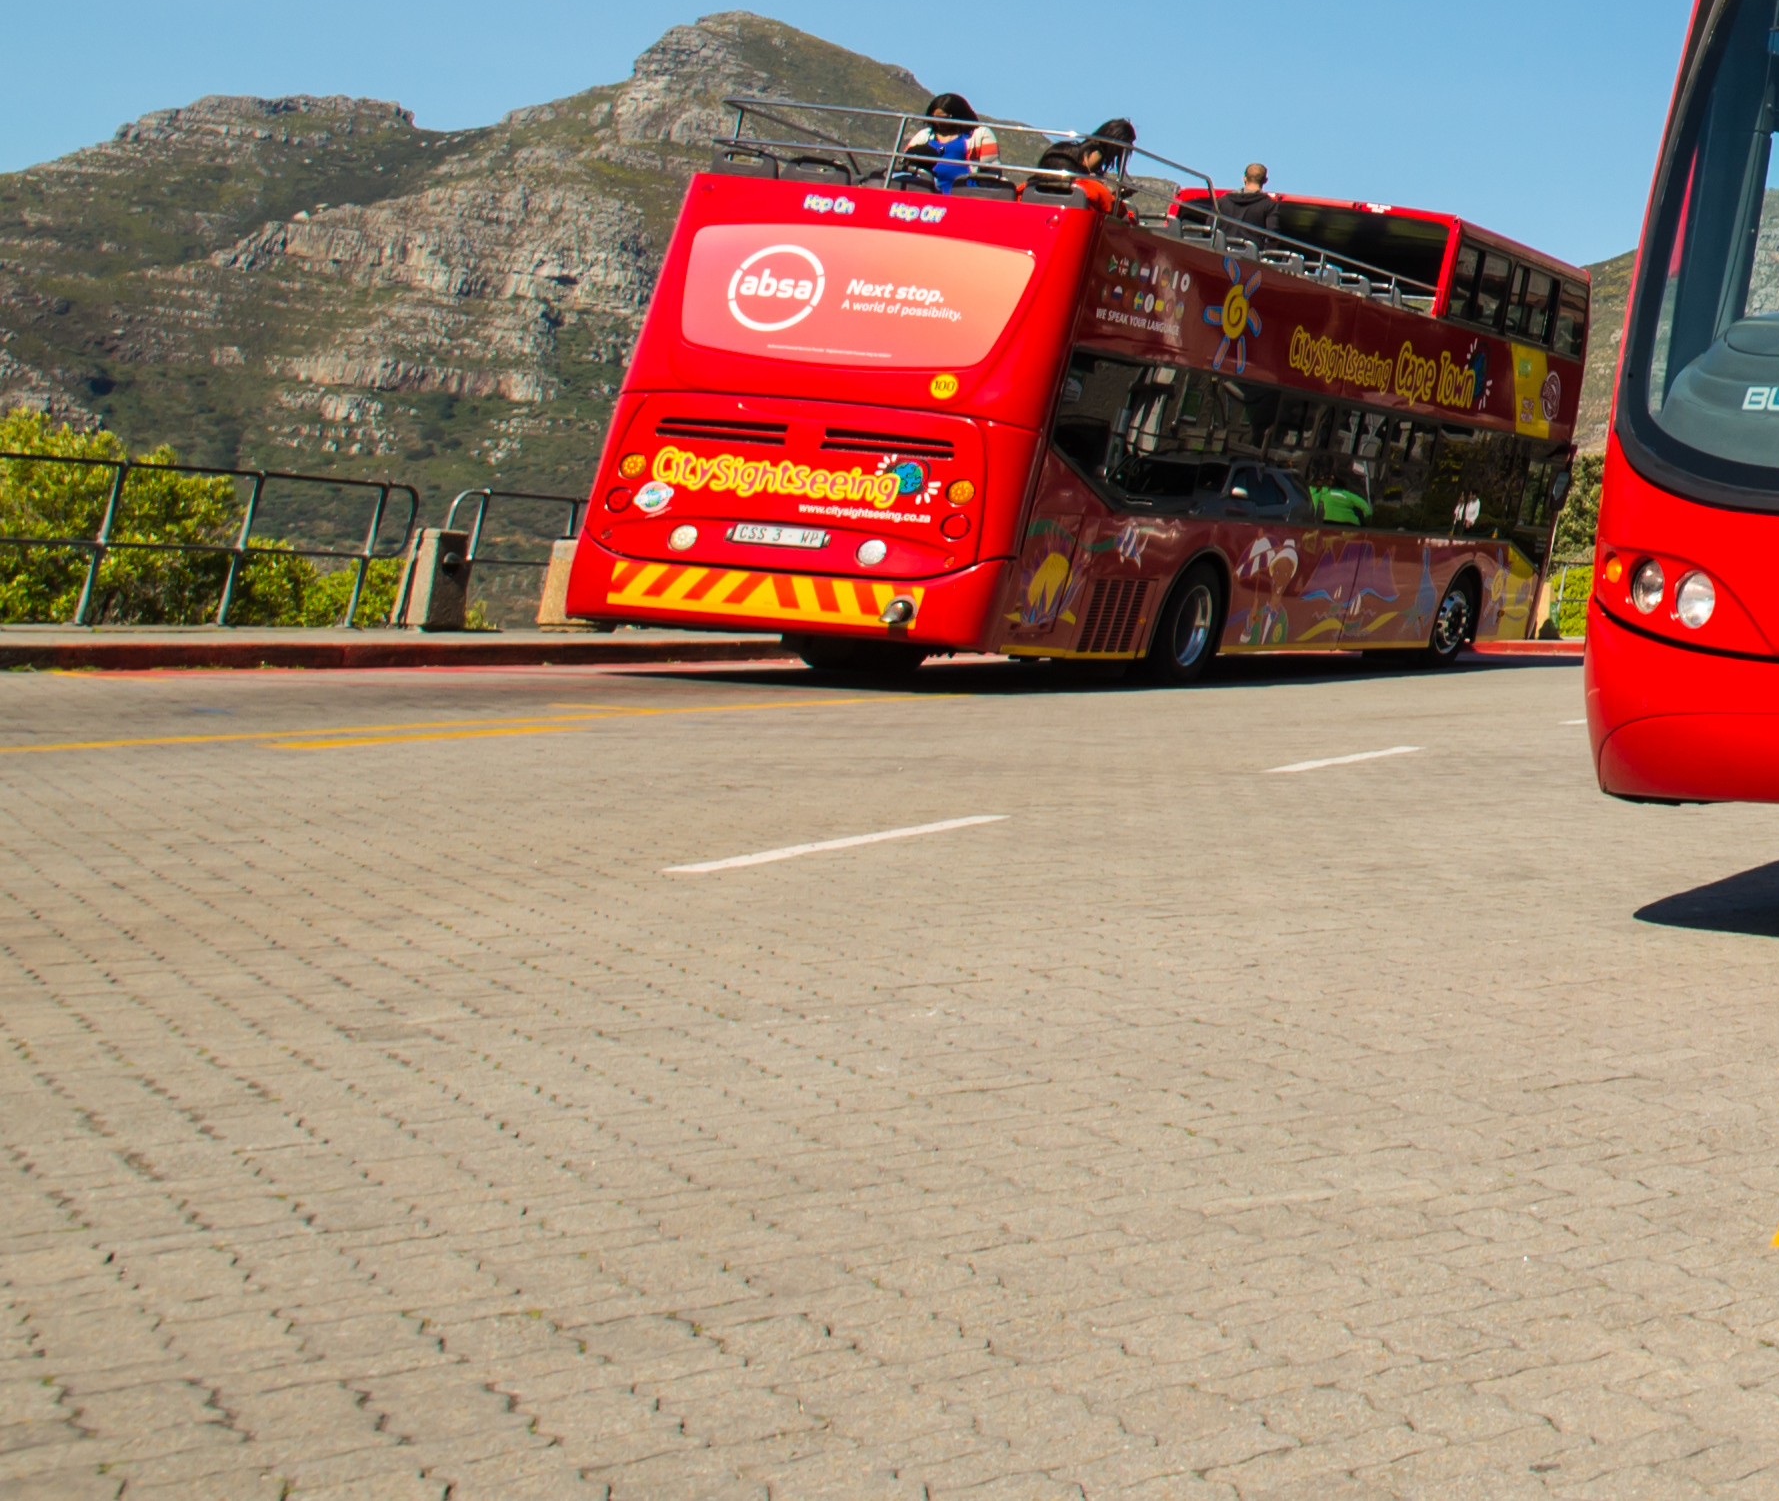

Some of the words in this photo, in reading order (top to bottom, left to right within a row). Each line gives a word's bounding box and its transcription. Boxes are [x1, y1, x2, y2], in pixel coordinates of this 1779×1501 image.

[803, 194, 833, 213] Hop
[833, 195, 855, 214] On
[889, 203, 918, 221] Hop
[919, 204, 946, 223] Off
[739, 268, 814, 300] absa
[846, 278, 894, 299] Next
[895, 285, 944, 306] stop.
[841, 301, 850, 310] A
[852, 302, 885, 314] world
[887, 303, 900, 314] of
[900, 305, 962, 321] possibility.
[1096, 307, 1107, 319] WE
[1108, 309, 1129, 325] SPEAK
[1129, 314, 1148, 328] YOUR
[1147, 319, 1180, 337] LANGUAGE
[1289, 325, 1393, 396] CitySightseeing
[1395, 340, 1437, 407] Cape
[1437, 351, 1476, 409] Town
[933, 380, 955, 393] 100
[652, 445, 901, 509] CitySightseeing
[798, 503, 931, 524] www.citysightseeing.co.za
[739, 526, 767, 541] CSS
[773, 528, 782, 542] 3
[800, 530, 819, 543] WP
